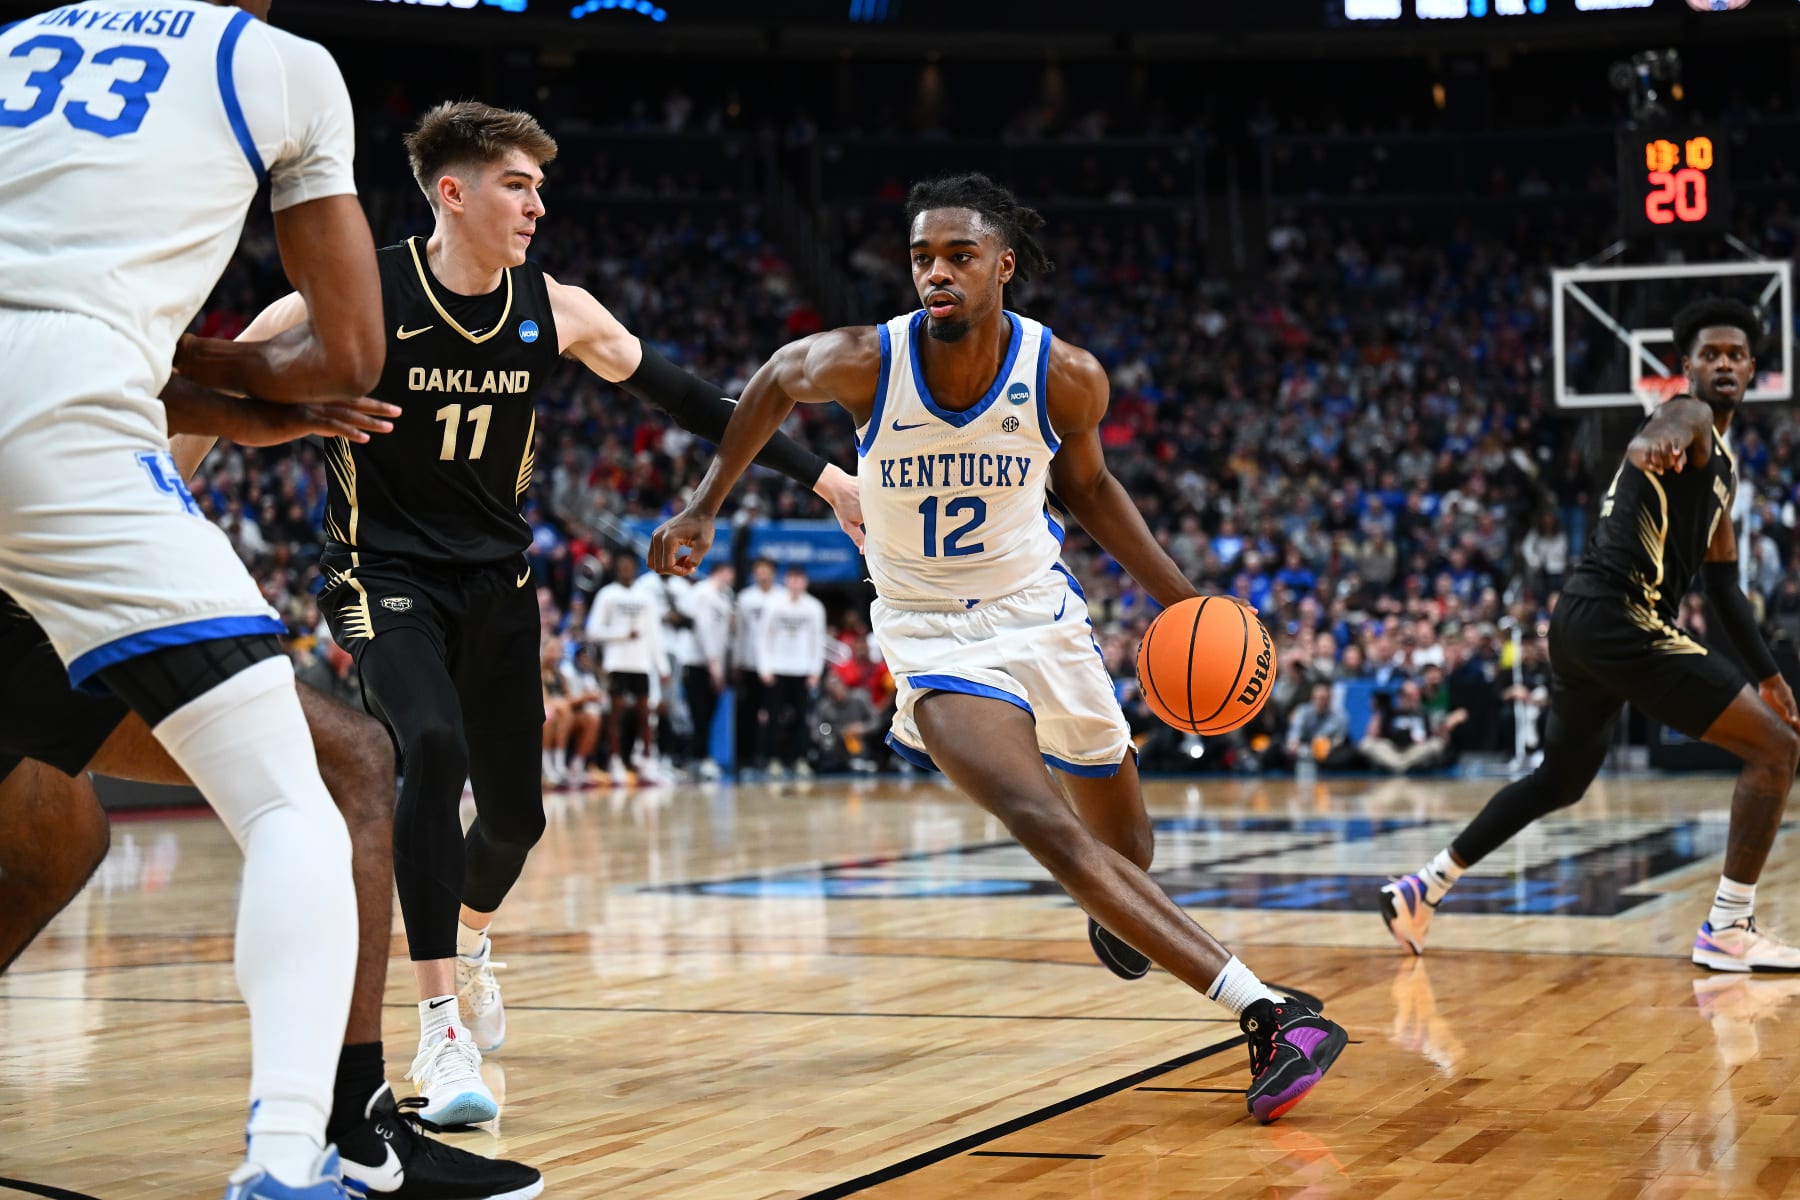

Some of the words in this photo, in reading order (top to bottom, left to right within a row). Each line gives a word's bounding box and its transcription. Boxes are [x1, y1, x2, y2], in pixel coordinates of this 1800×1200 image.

[39, 9, 195, 38] ONYENSO
[0, 34, 170, 138] 33
[1645, 168, 1708, 224] 20
[408, 367, 530, 394] OAKLAND
[435, 403, 493, 461] 11
[1002, 416, 1019, 432] SEC
[880, 453, 1031, 488] KENTUCKY
[918, 495, 987, 558] 12
